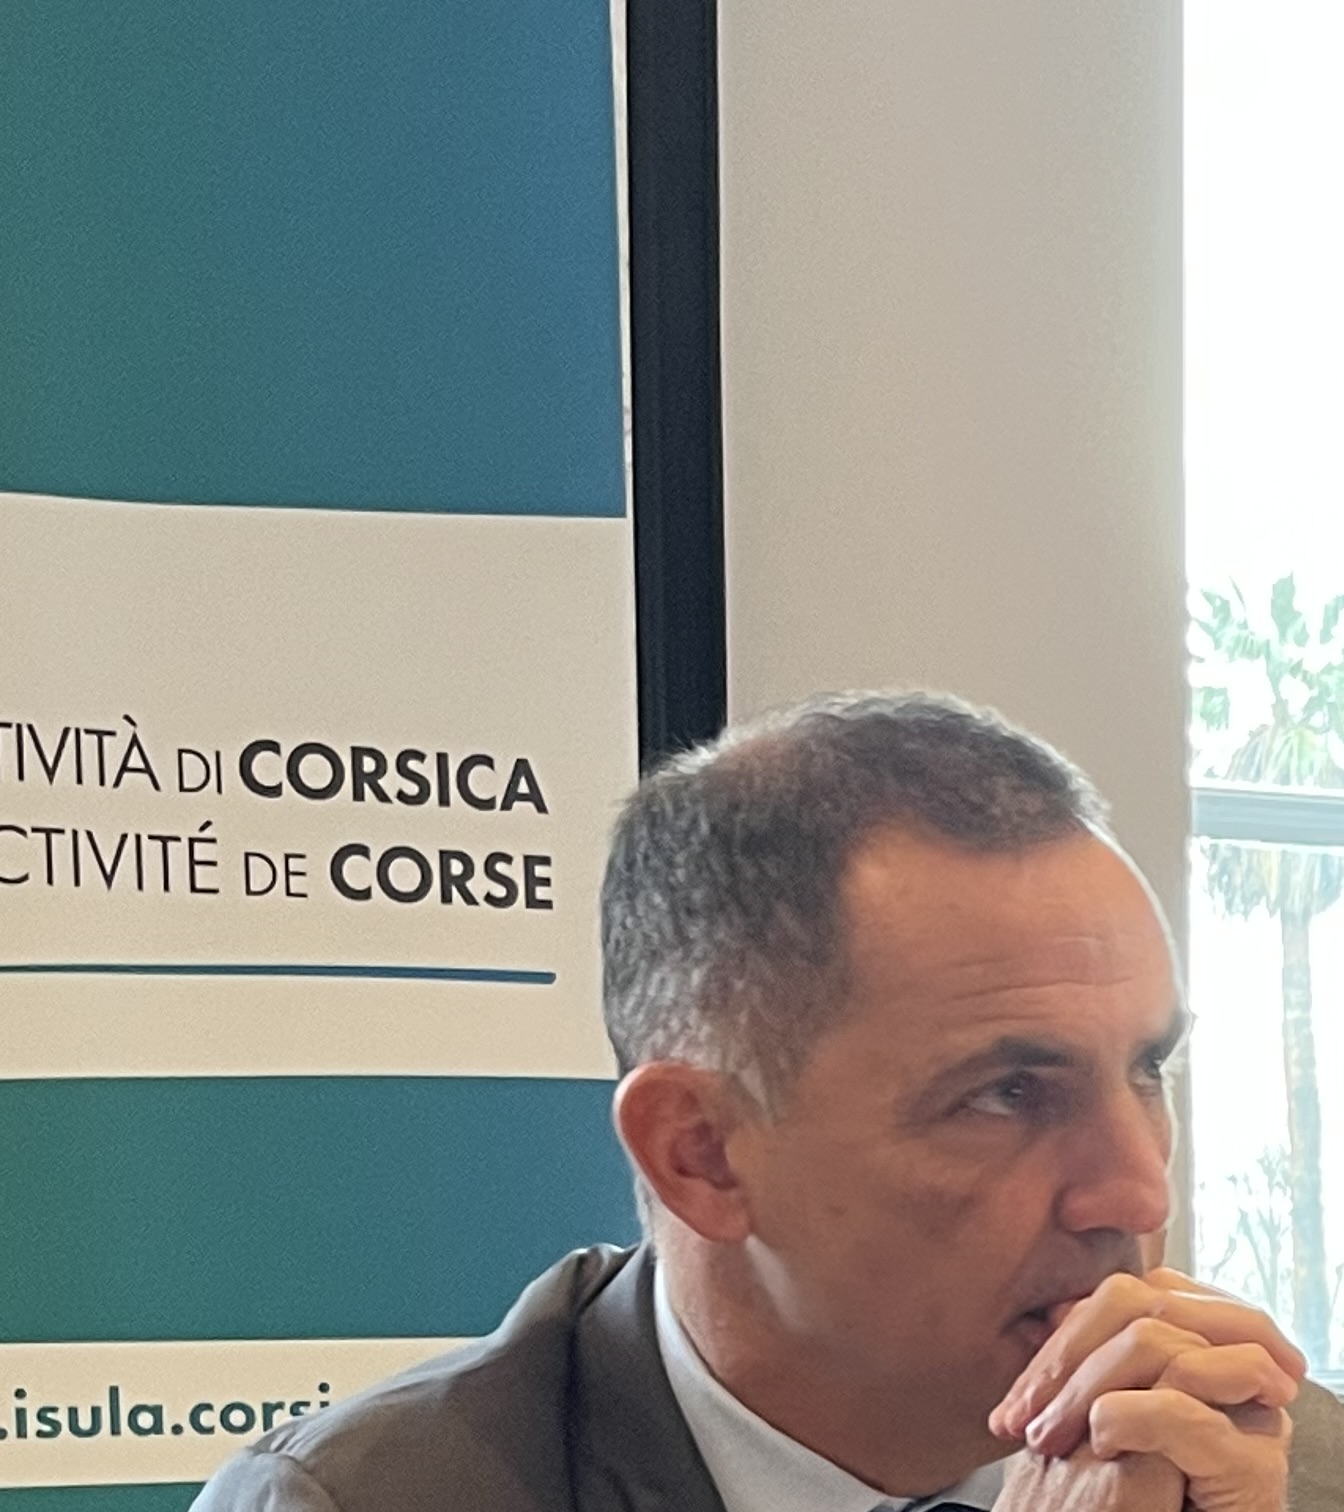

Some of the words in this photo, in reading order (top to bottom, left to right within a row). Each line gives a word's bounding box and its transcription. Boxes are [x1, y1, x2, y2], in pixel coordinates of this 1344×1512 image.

[177, 748, 222, 795] DI
[238, 739, 549, 814] CORSICA
[244, 852, 308, 898] DE
[330, 843, 554, 910] CORSE
